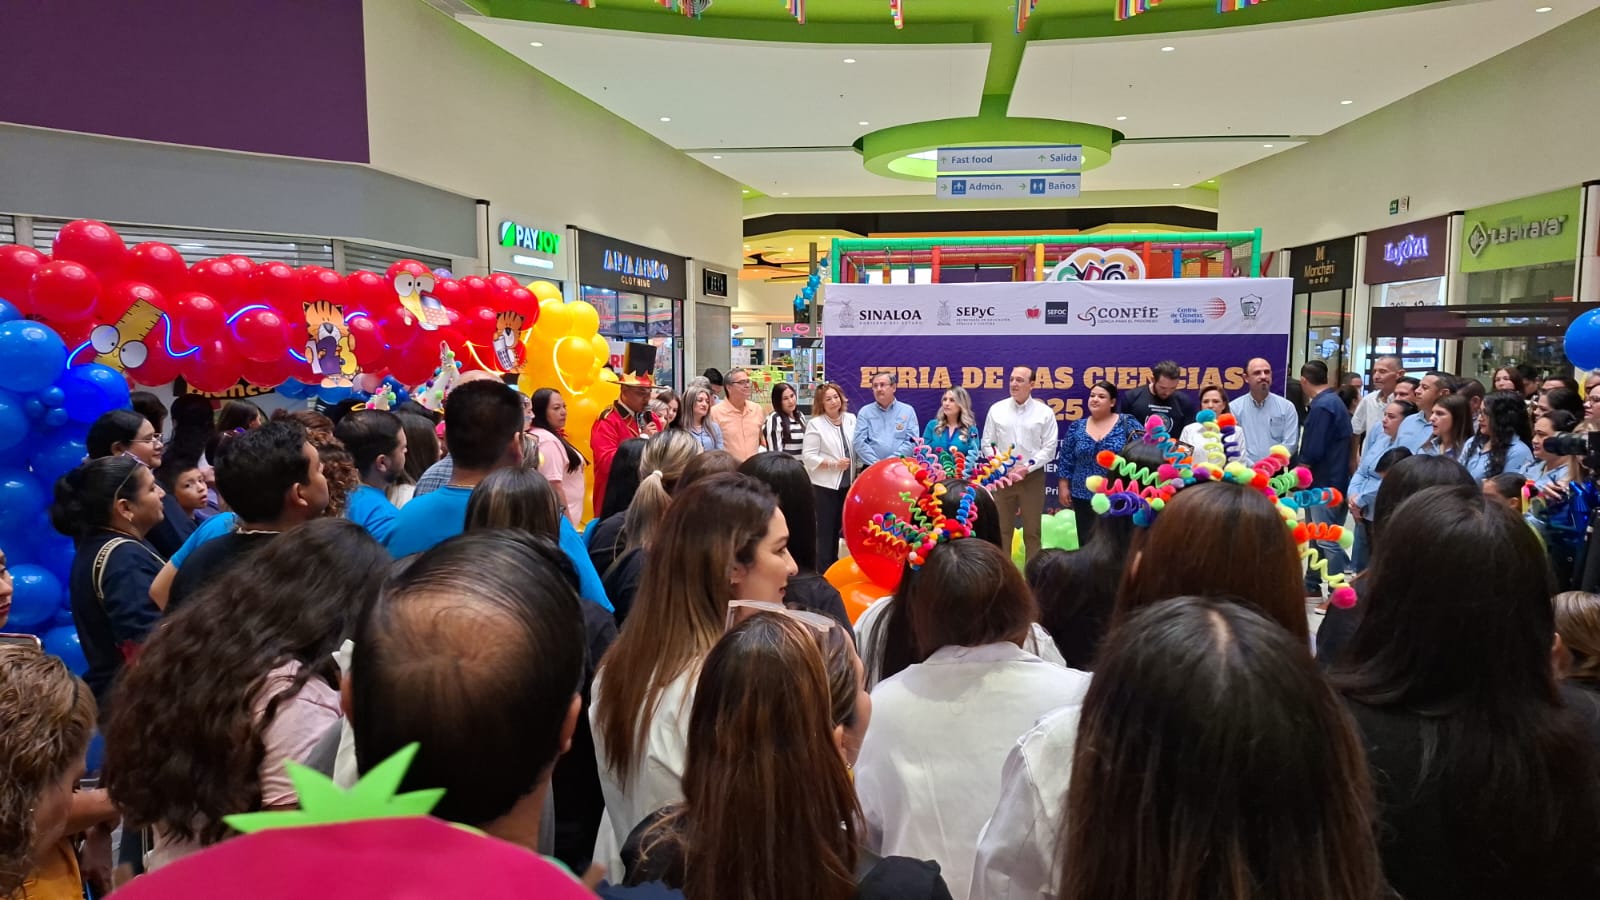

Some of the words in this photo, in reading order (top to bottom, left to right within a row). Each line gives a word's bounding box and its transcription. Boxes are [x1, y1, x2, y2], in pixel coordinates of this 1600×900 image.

[951, 156, 970, 164] Fast
[971, 155, 993, 164] food
[1049, 153, 1078, 162] Salida
[1048, 181, 1076, 190] Baños
[620, 275, 652, 289] CLOTHING
[859, 309, 922, 321] SINALOA
[956, 306, 995, 319] SEPyC
[962, 366, 1004, 389] DE
[1031, 366, 1074, 390] AS
